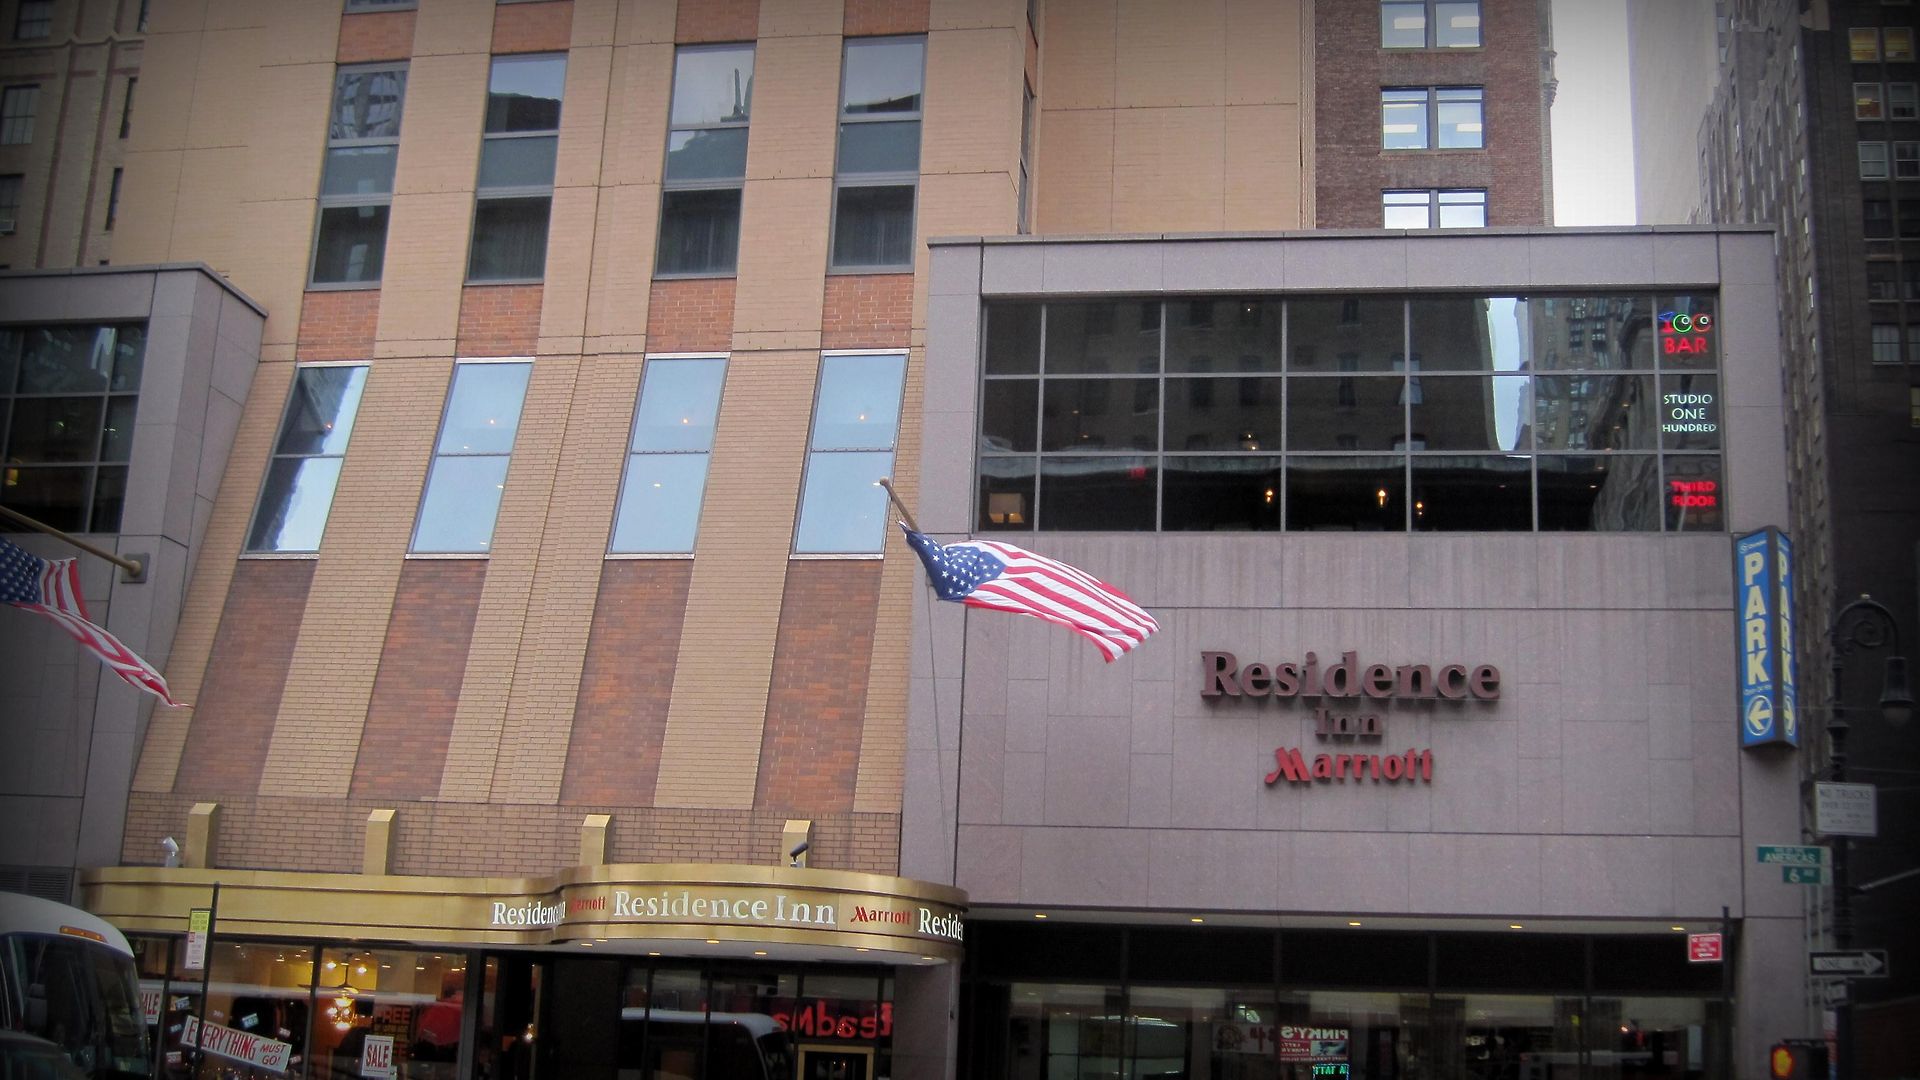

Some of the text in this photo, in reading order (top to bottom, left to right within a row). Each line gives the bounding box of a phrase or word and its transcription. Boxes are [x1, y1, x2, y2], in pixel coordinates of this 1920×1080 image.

[1664, 337, 1708, 354] BAR
[1663, 394, 1713, 405] STUDIO
[1671, 408, 1706, 420] ONE
[1662, 423, 1717, 432] HUNDRED
[1670, 481, 1717, 492] THIRD
[1671, 495, 1717, 506] FLOOR
[1744, 551, 1770, 686] PARK
[1777, 550, 1793, 686] PARK
[1201, 650, 1500, 699] Residence
[1315, 706, 1383, 737] Inn
[1264, 746, 1433, 784] Marriott
[1789, 867, 1799, 883] 6
[614, 889, 836, 925] Residence Inn
[850, 906, 912, 925] Marriott
[260, 1044, 286, 1054] MUST
[365, 1043, 390, 1068] SALE
[262, 1055, 282, 1066] GO!
